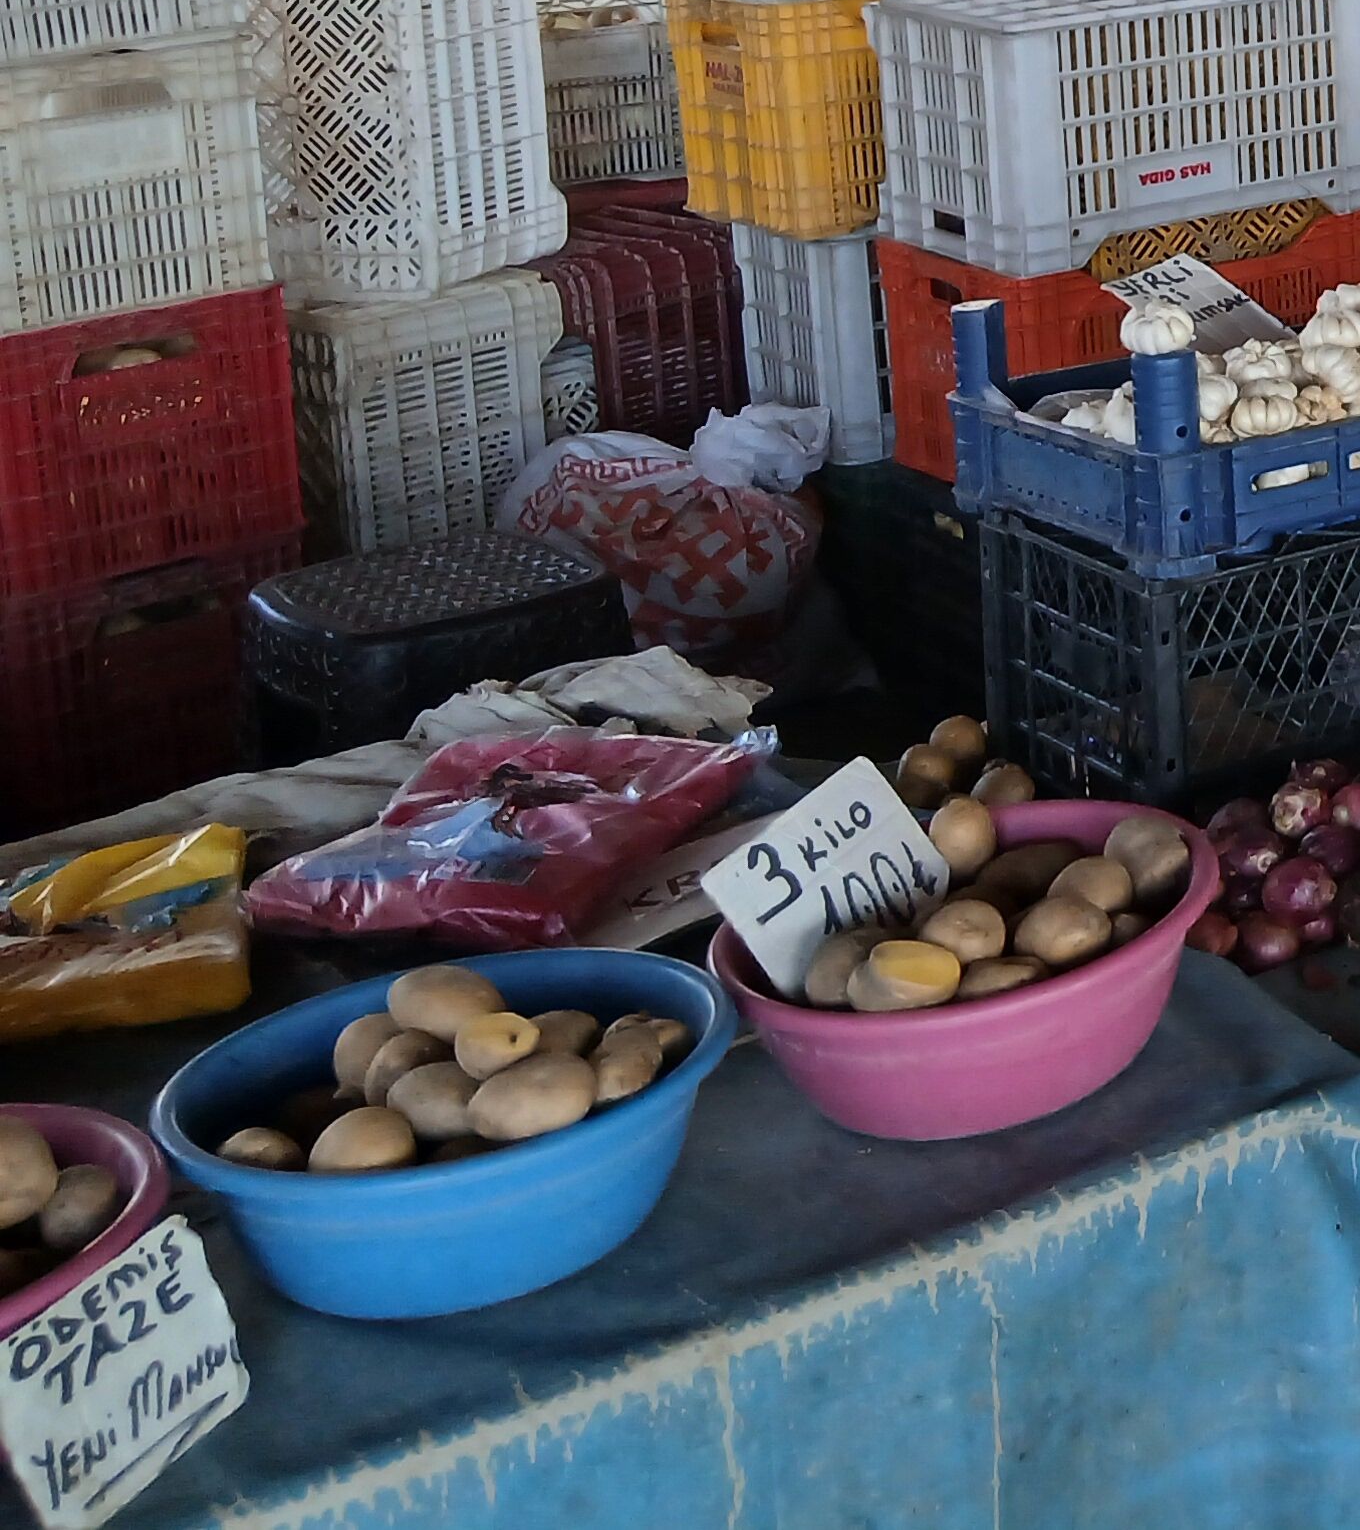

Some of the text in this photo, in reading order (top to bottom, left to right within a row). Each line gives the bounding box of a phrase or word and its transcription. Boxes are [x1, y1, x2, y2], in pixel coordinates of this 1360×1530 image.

[1138, 161, 1211, 186] HAS GIDA
[748, 843, 802, 925] 3
[44, 1270, 195, 1404] TAZE
